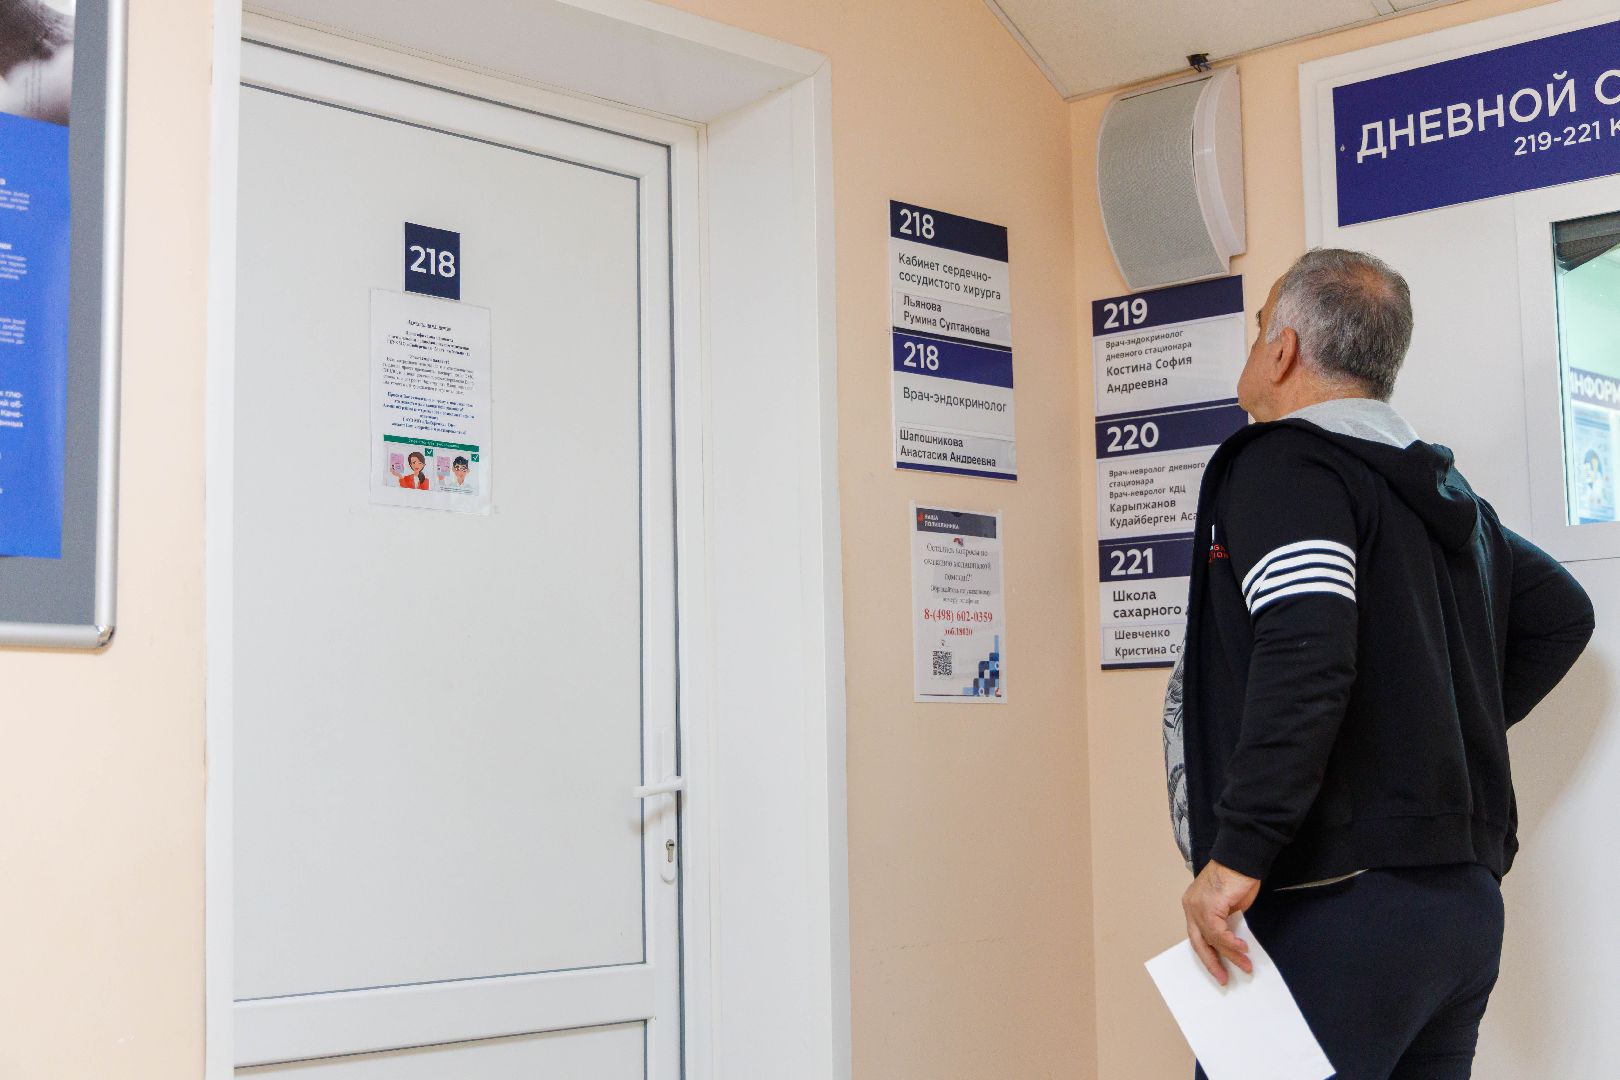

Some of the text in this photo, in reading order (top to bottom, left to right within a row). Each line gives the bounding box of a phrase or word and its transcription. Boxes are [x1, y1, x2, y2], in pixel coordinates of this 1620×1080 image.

[1356, 70, 1577, 164] ДНЕВНОЙ
[1514, 120, 1601, 156] 219-221
[899, 208, 935, 240] 218
[409, 245, 456, 278] 218
[898, 252, 992, 282] Кабинет сердечно-
[899, 271, 1001, 300] сосудистого хирурга
[903, 295, 942, 313] Льянова
[1103, 298, 1148, 330] 219
[903, 311, 990, 337] Румина Султановна
[1105, 329, 1184, 349] Врач-эндокринолог
[903, 341, 940, 371] 218
[1105, 341, 1192, 362] дневного стационара
[1106, 355, 1192, 377] Костина София
[1106, 377, 1168, 395] Андреевна
[903, 386, 1007, 413] Врач-эндокринолог
[900, 429, 964, 448] Шапошникова
[1107, 421, 1159, 453] 220
[900, 445, 997, 467] Анастасия Андреевна
[1109, 461, 1206, 479] Врач-невролог дневного
[1109, 477, 1154, 489] стационара
[1109, 485, 1186, 500] Врач-невролог КДЦ
[1109, 499, 1176, 515] Карыпжанов
[1110, 514, 1176, 530] Кудайберген
[1110, 547, 1154, 576] 221
[1113, 590, 1157, 602] Школа
[924, 608, 993, 623] 8-(498) 602-0359
[1113, 605, 1182, 620] сахарного
[1114, 628, 1170, 640] Шевченко
[1115, 644, 1167, 660] Кристина
